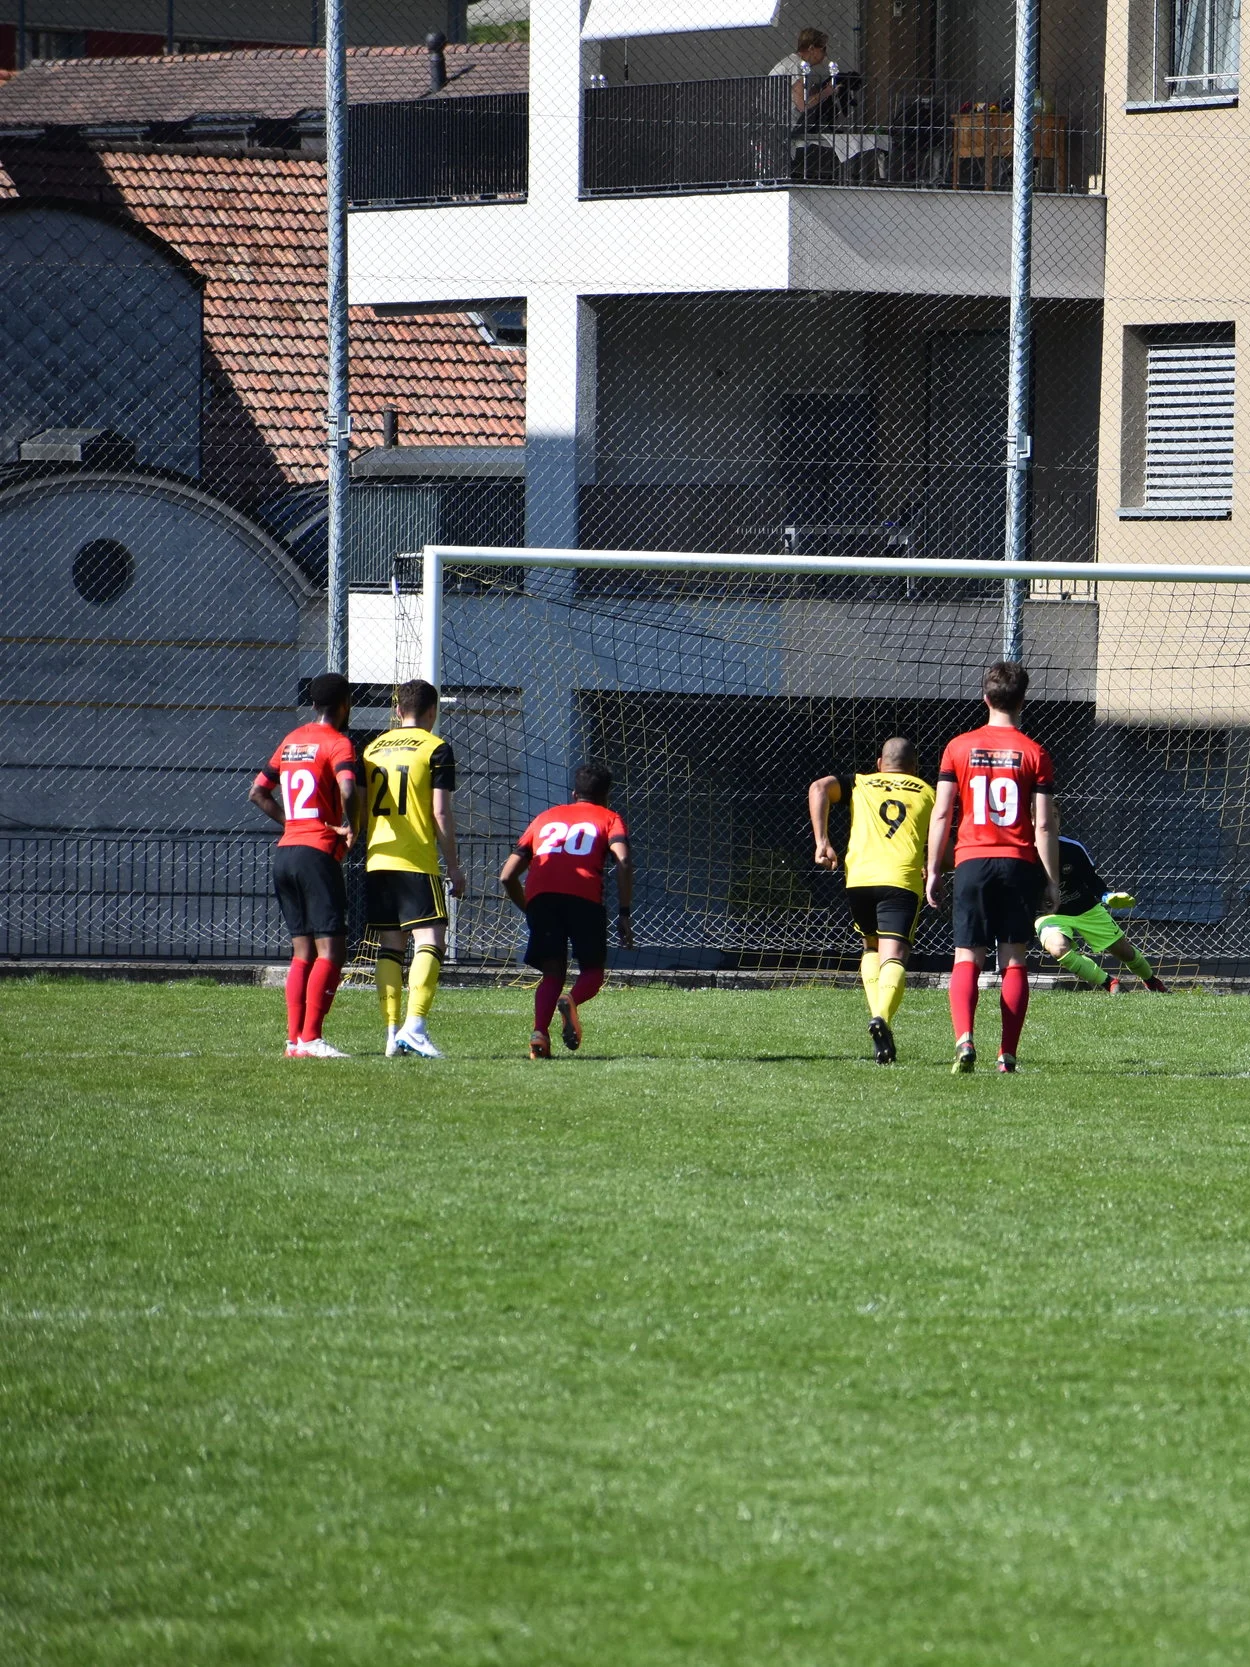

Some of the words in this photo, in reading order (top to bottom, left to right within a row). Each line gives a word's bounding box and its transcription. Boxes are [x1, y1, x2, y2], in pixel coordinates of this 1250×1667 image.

[280, 769, 319, 820] 12
[371, 764, 410, 817] 21
[969, 775, 1020, 827] 19
[536, 821, 598, 856] 20
[879, 799, 907, 840] 9
